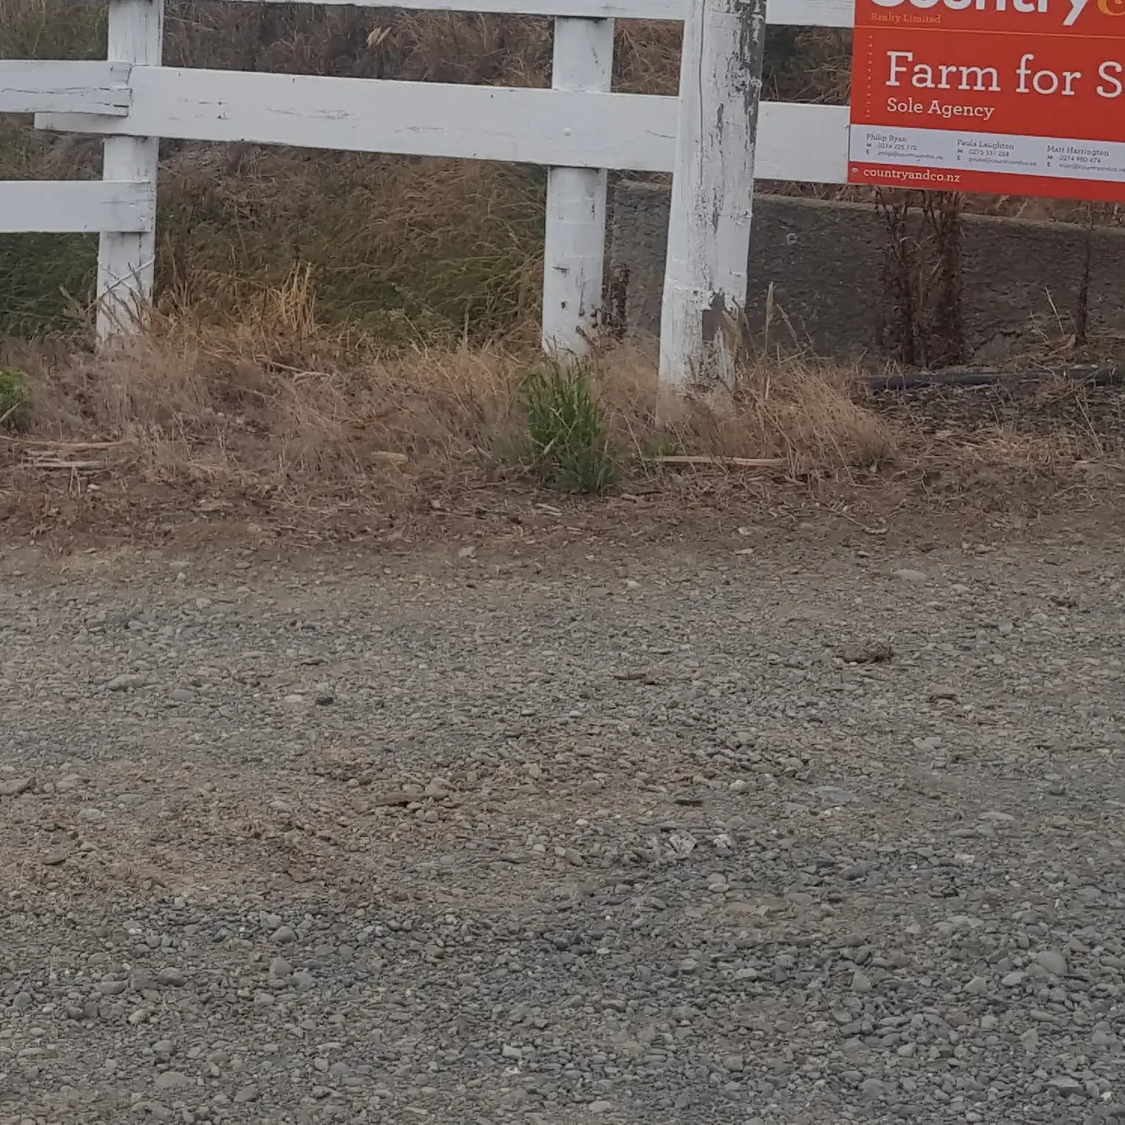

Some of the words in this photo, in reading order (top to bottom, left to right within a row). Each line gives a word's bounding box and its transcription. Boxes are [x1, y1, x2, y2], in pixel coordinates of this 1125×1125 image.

[871, 12, 901, 24] Realty
[903, 13, 941, 24] Limited
[886, 50, 1001, 92] Farm
[1015, 53, 1081, 96] for
[1096, 60, 1123, 98] S
[887, 97, 923, 114] Sole
[927, 99, 995, 121] Agency
[866, 133, 887, 143] Philip
[889, 134, 907, 143] Ryan
[957, 139, 977, 147] Paula
[979, 140, 1015, 150] Laughton
[1047, 145, 1064, 153] Matt
[1066, 146, 1110, 157] Harrington
[863, 168, 961, 184] countryandco.nz
